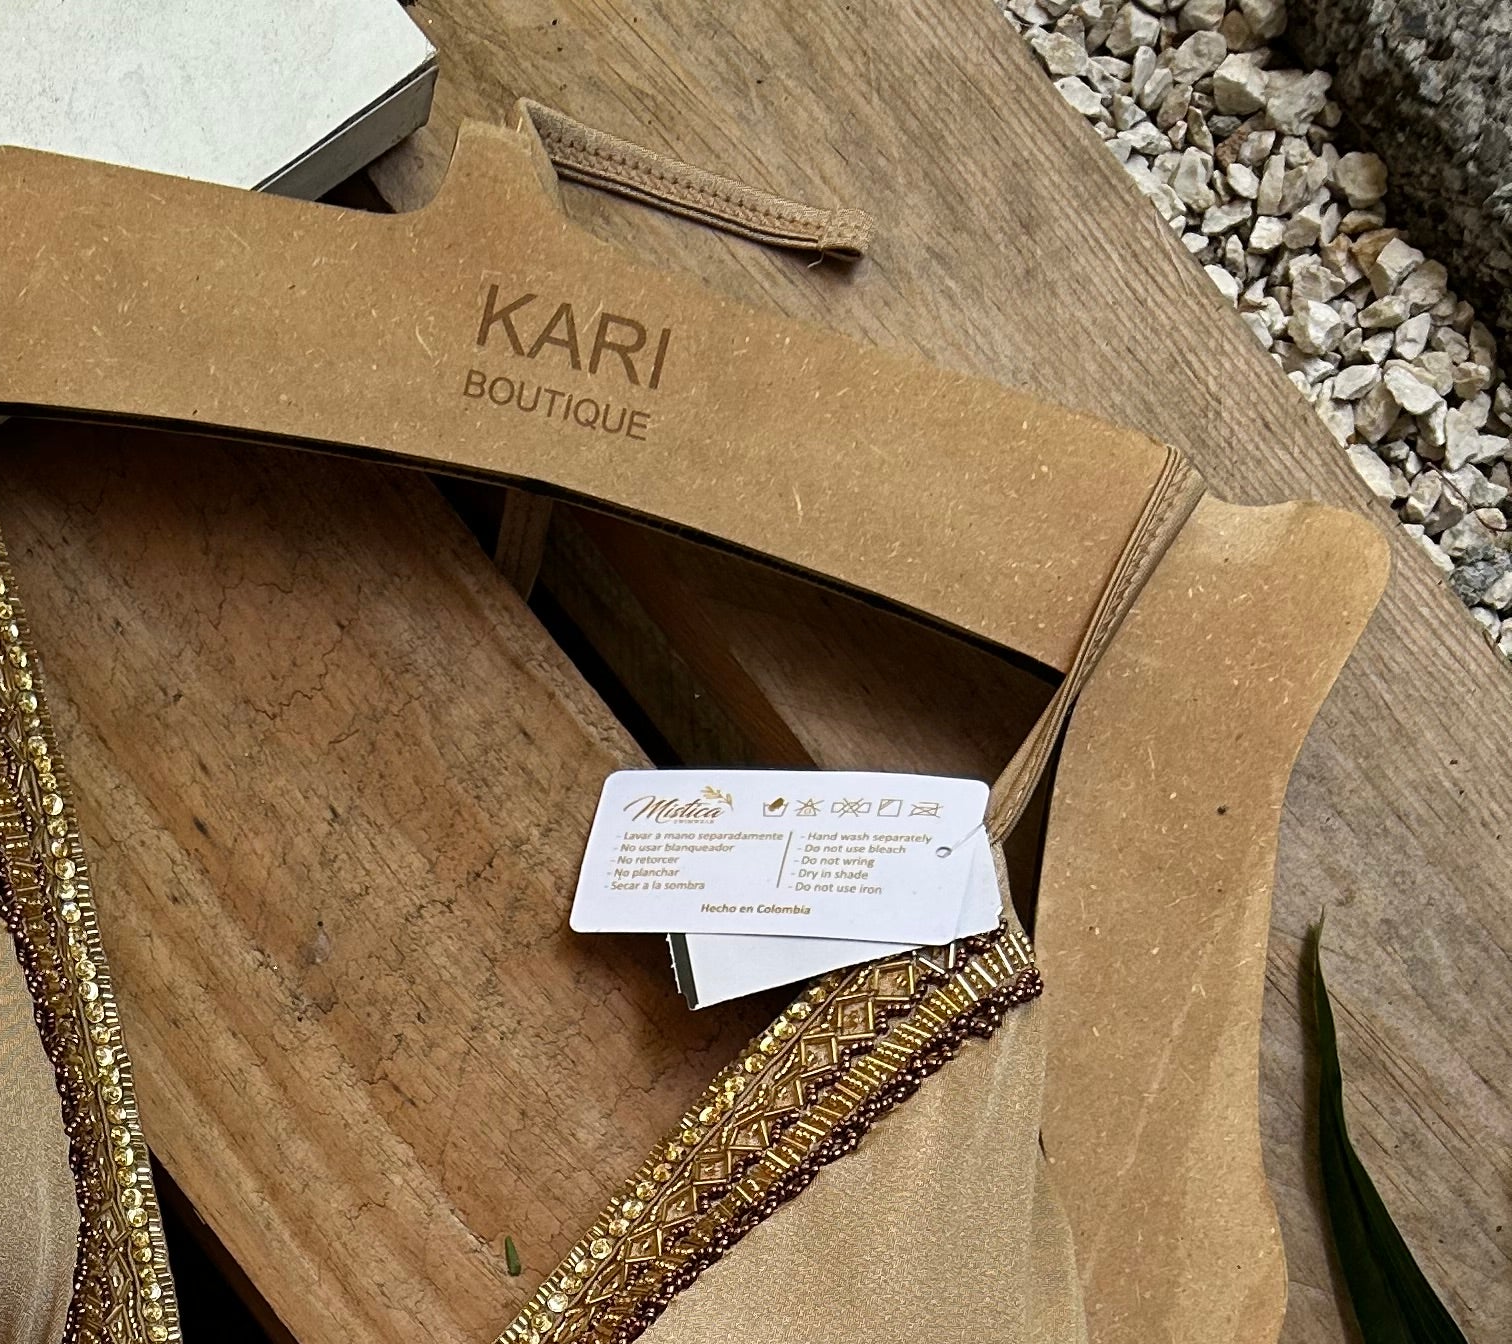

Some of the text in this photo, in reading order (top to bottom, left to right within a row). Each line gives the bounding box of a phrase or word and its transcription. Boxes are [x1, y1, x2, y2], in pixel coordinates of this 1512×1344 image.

[476, 284, 671, 390] KARI
[463, 369, 651, 441] BOUTIQUE
[623, 831, 784, 841] Lavar a mano separadamente
[808, 832, 932, 845] Hand wash separately
[620, 843, 636, 851] No
[664, 843, 735, 853] blanqueador
[804, 844, 906, 854] Do not use bleach
[617, 855, 680, 864] No retorcer
[801, 856, 875, 868] Do not wring
[614, 867, 680, 879] No planchar
[798, 868, 868, 880] Dry in shade
[610, 880, 705, 890] Secar a la sombra
[795, 881, 882, 895] Do not use iron
[701, 903, 811, 915] Hecho en Colombia
